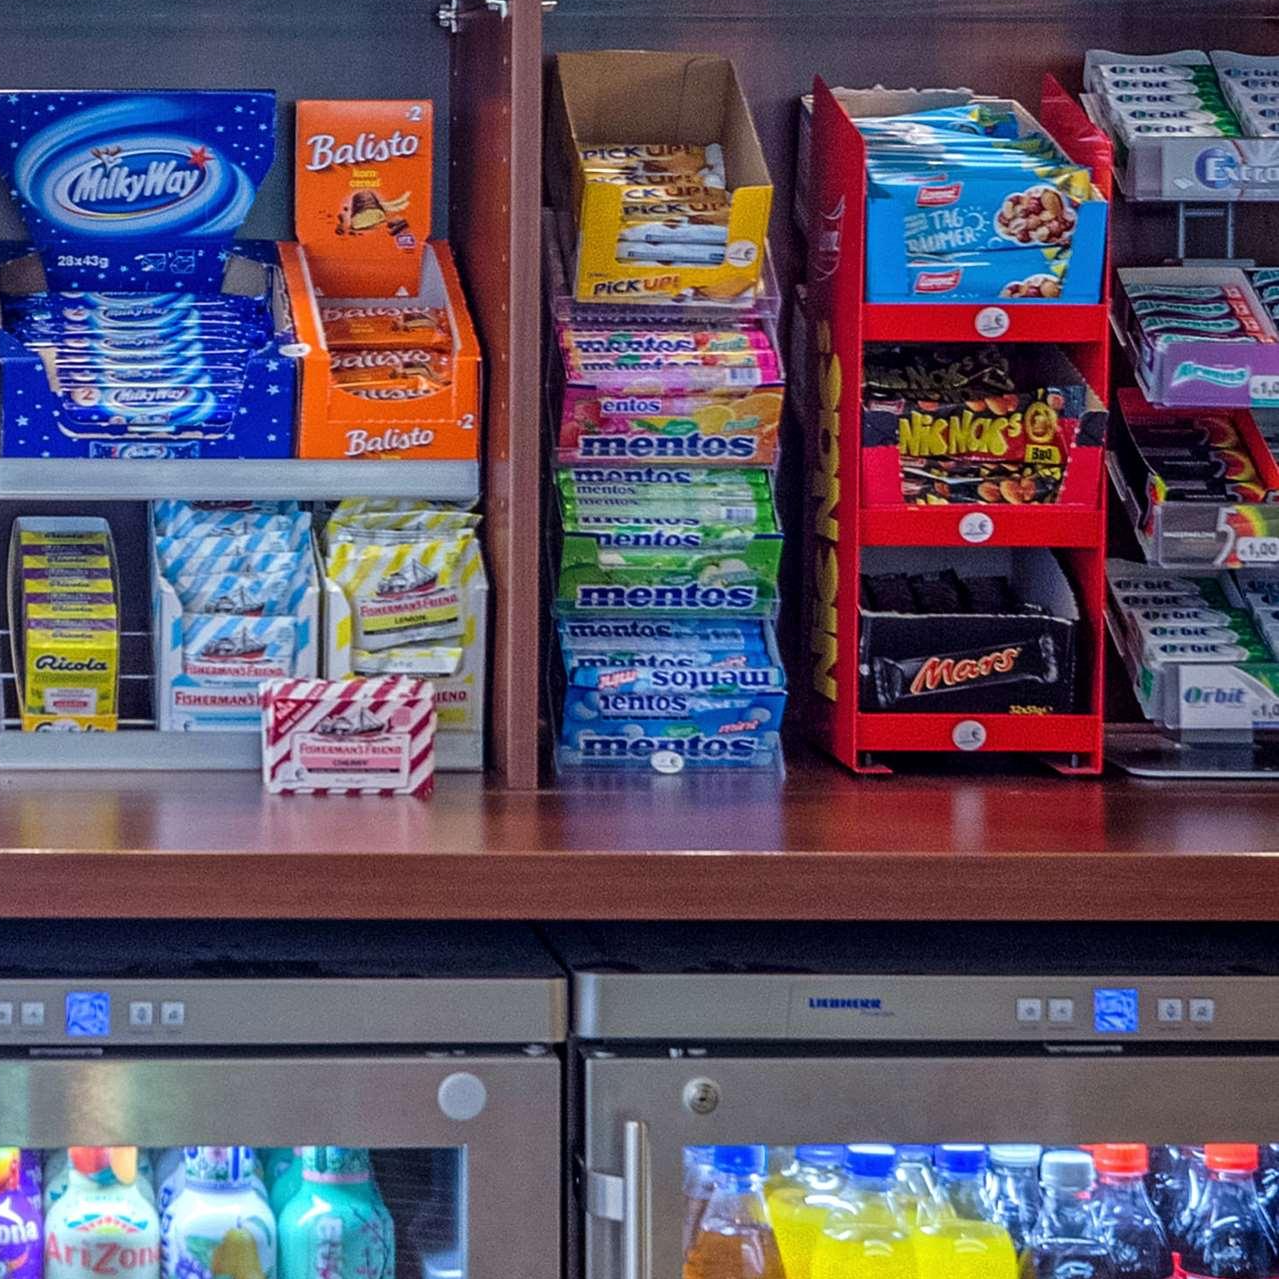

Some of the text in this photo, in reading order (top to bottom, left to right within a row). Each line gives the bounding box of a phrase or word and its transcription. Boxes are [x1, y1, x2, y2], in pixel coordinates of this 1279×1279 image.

[1109, 65, 1165, 74] Orbit
[1112, 79, 1171, 90] Orbit
[1116, 93, 1178, 104] Orbit
[1129, 109, 1188, 120] Orbit
[1134, 123, 1194, 134] Orbit
[306, 130, 419, 172] Balisto
[57, 255, 110, 270] 28x43g
[644, 275, 681, 290] UP!
[602, 399, 661, 413] entos
[344, 426, 434, 457] Balisto
[580, 435, 756, 459] mentos
[574, 470, 692, 484] mentos
[578, 585, 756, 609] mentos
[1142, 610, 1201, 620] Orbit
[571, 623, 671, 640] mentos
[1150, 626, 1208, 637] Orbit
[1159, 643, 1220, 654] Orbit
[35, 655, 108, 671] Ricola
[911, 648, 1022, 695] Mars
[175, 691, 256, 707] FISHERMAN'S
[1184, 685, 1246, 705] Orbit
[365, 745, 402, 755] FRIEND
[581, 736, 756, 759] mentos
[809, 998, 881, 1010] LIEBHERR
